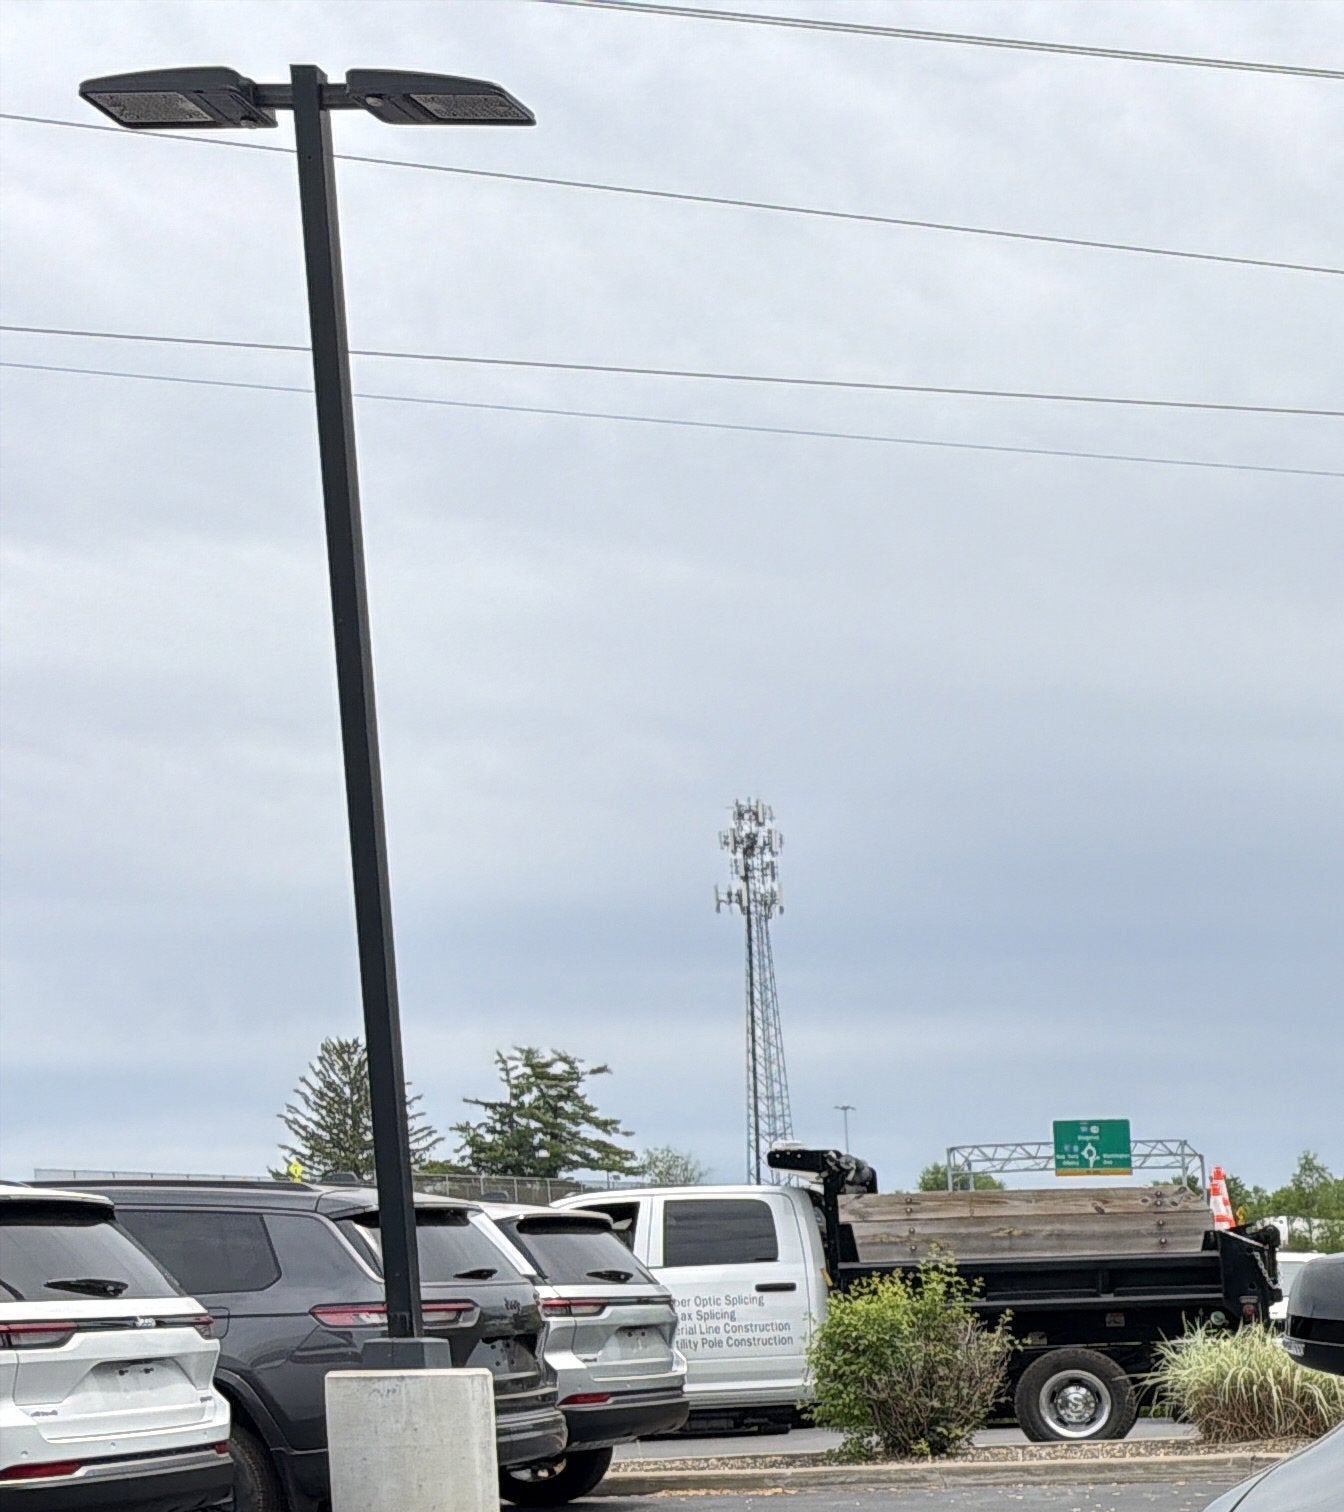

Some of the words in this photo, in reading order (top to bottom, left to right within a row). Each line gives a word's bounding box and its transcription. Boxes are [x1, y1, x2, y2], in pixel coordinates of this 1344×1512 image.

[694, 1296, 721, 1308] Optic
[724, 1294, 765, 1307] Splicing
[696, 1309, 737, 1322] Splicing
[677, 1323, 697, 1336] erial
[699, 1323, 720, 1335] Line
[723, 1322, 791, 1334] Construction
[675, 1339, 698, 1351] tility
[701, 1337, 723, 1349] Pole
[726, 1335, 794, 1348] Construction
